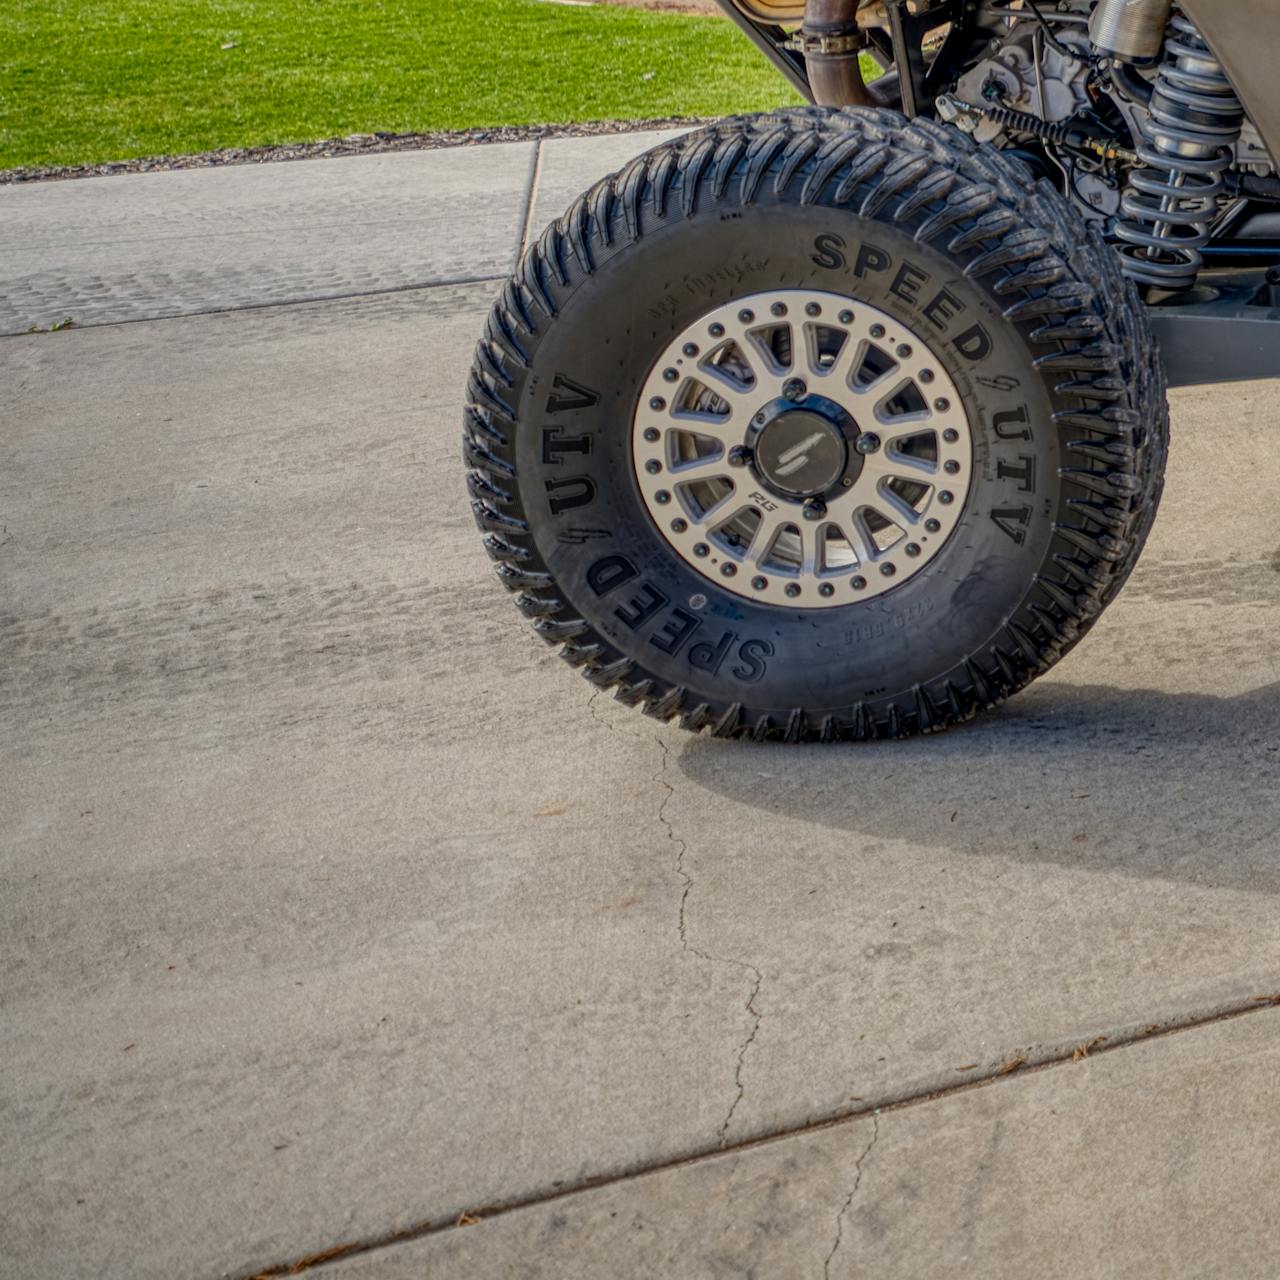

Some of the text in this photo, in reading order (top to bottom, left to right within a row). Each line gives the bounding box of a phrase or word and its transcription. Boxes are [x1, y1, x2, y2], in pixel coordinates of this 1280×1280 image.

[542, 373, 776, 683] SPEED UTV
[811, 231, 1037, 546] SPEED UTV
